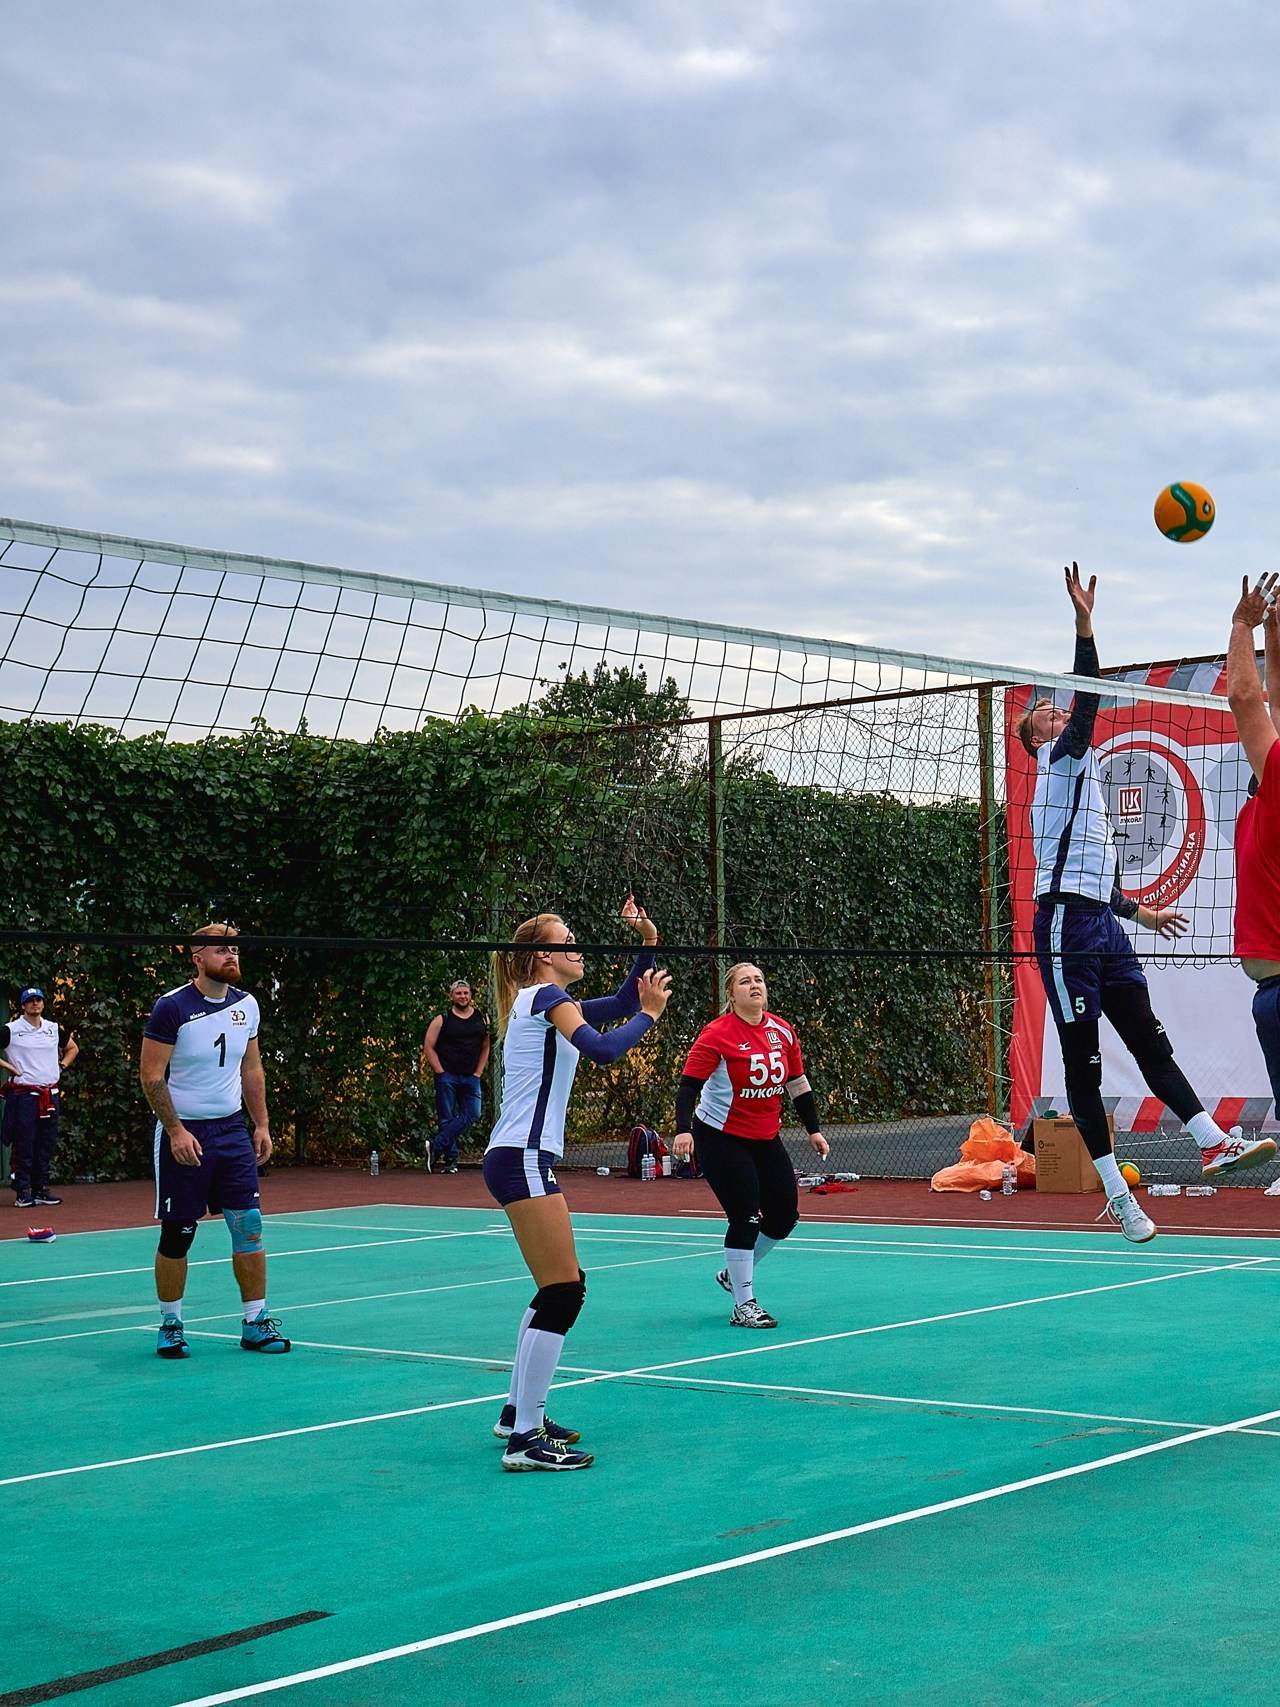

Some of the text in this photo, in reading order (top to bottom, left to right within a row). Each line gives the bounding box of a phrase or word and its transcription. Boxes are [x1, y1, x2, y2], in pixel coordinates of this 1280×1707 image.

[1076, 997, 1086, 1014] 5
[214, 1033, 226, 1067] 1
[750, 1051, 785, 1086] 55
[547, 1167, 557, 1185] 4
[165, 1198, 171, 1212] 1
